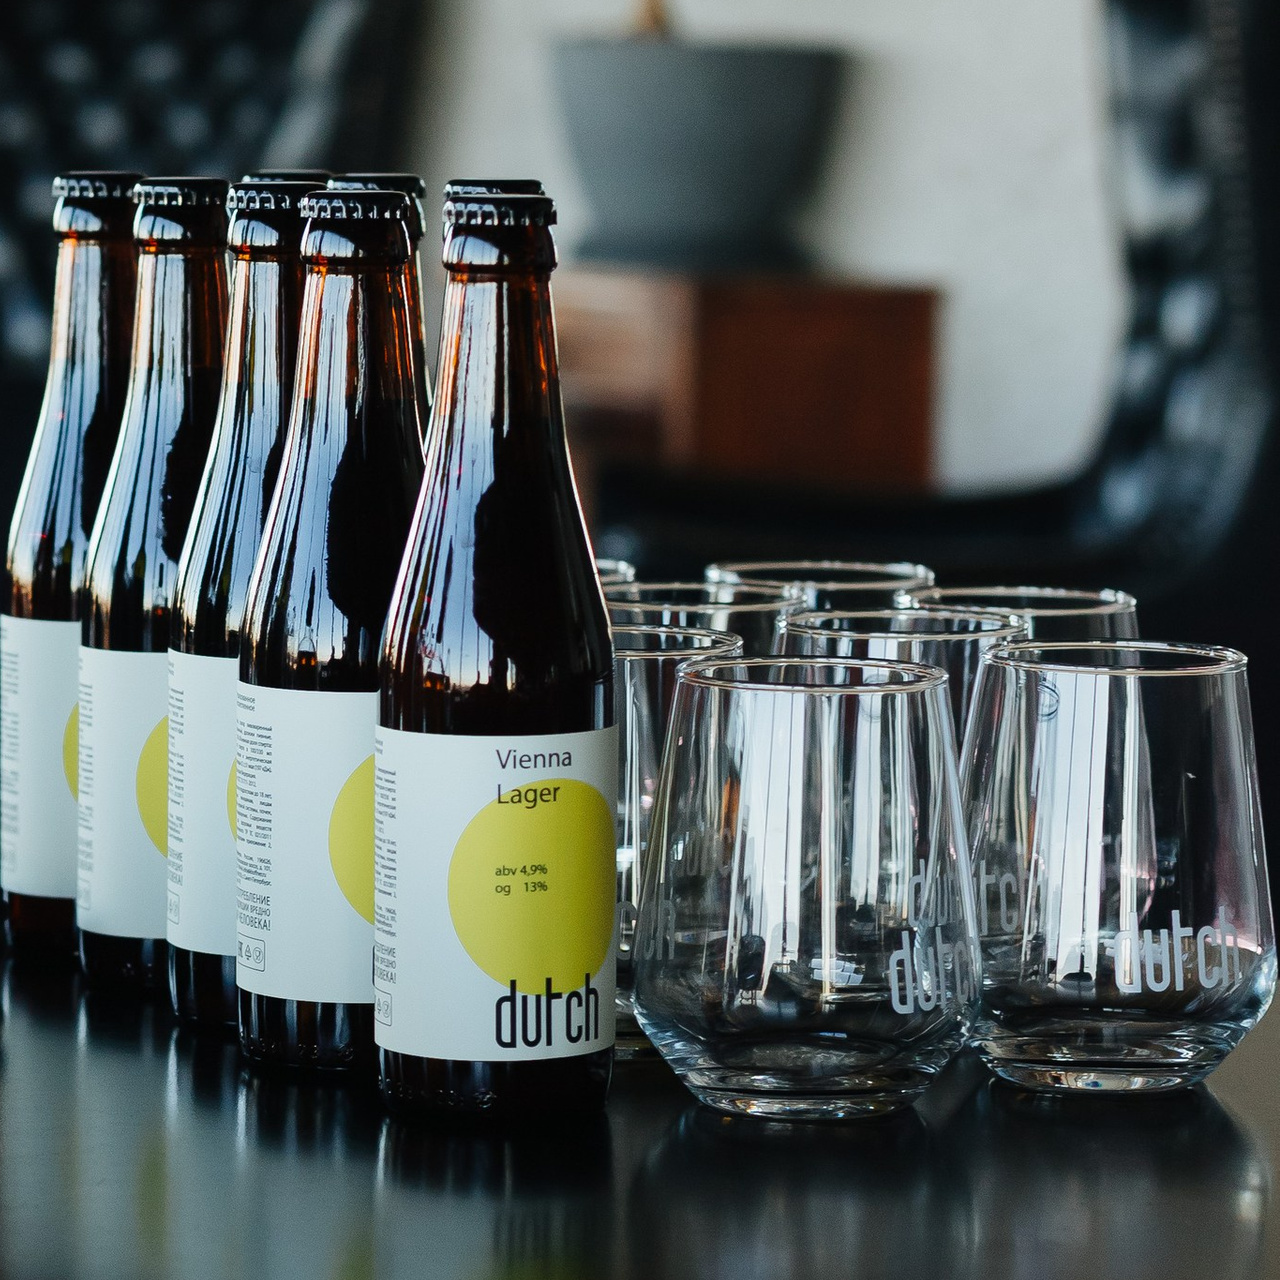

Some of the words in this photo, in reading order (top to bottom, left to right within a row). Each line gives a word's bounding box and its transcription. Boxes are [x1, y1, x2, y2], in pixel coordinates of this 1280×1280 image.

[496, 749, 572, 769] Vienna
[497, 784, 560, 809] Lager
[495, 865, 517, 877] abv
[520, 864, 548, 877] 4,9%
[495, 884, 511, 896] og
[524, 881, 548, 893] 13%
[1114, 906, 1240, 993] dutch
[495, 972, 599, 1049] dutch
